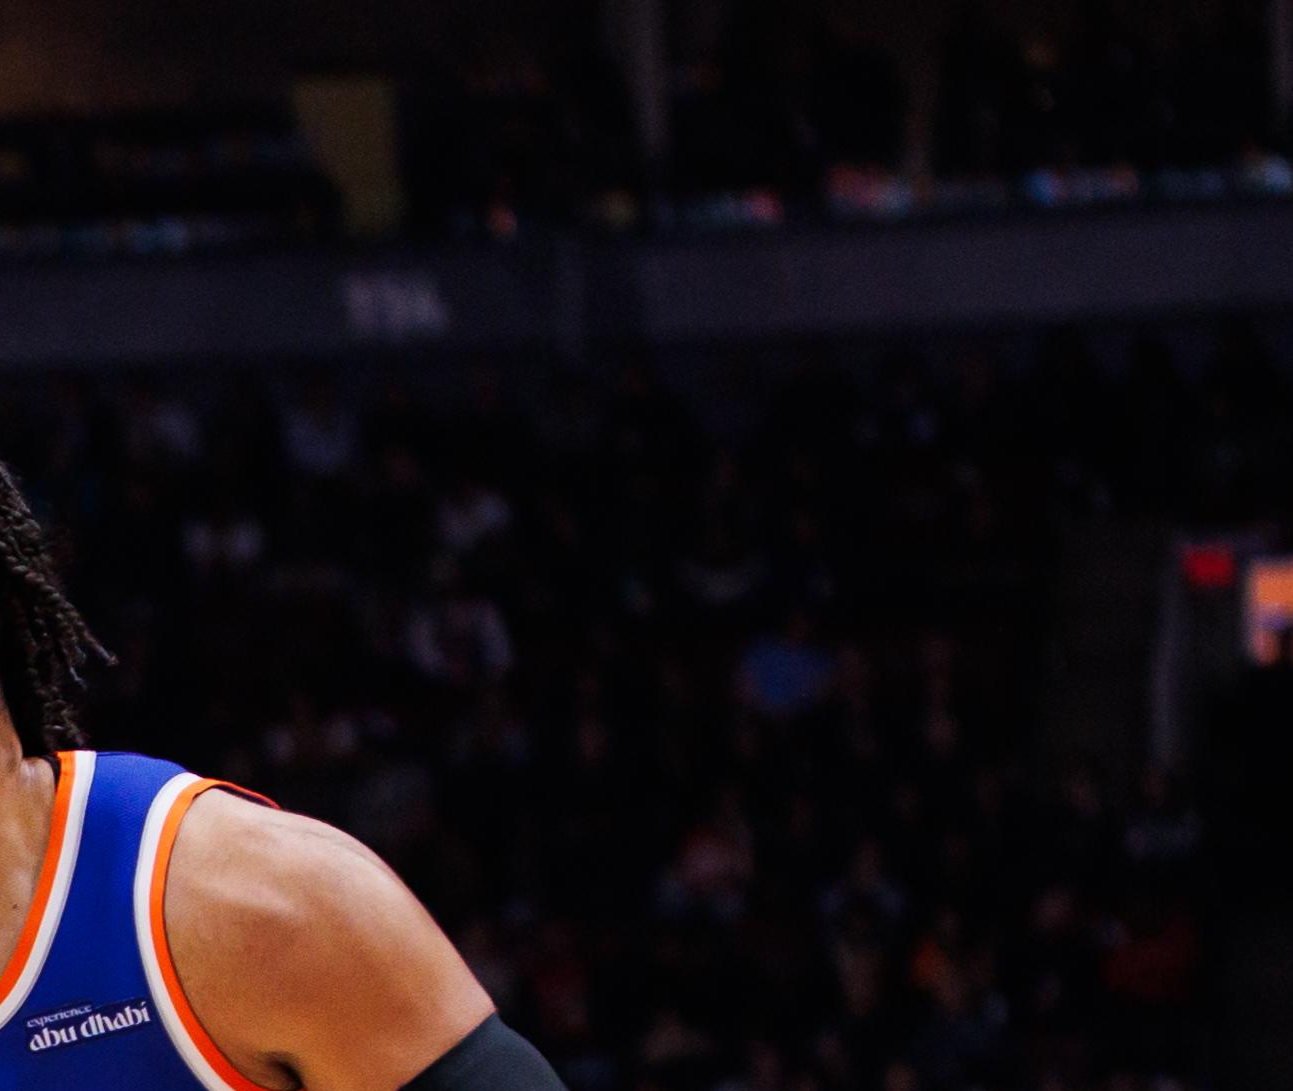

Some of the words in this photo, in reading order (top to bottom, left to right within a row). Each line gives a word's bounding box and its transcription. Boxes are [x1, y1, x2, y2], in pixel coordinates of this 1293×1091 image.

[26, 1004, 93, 1028] experience
[29, 1026, 78, 1051] abu
[80, 1001, 151, 1038] dhabi
